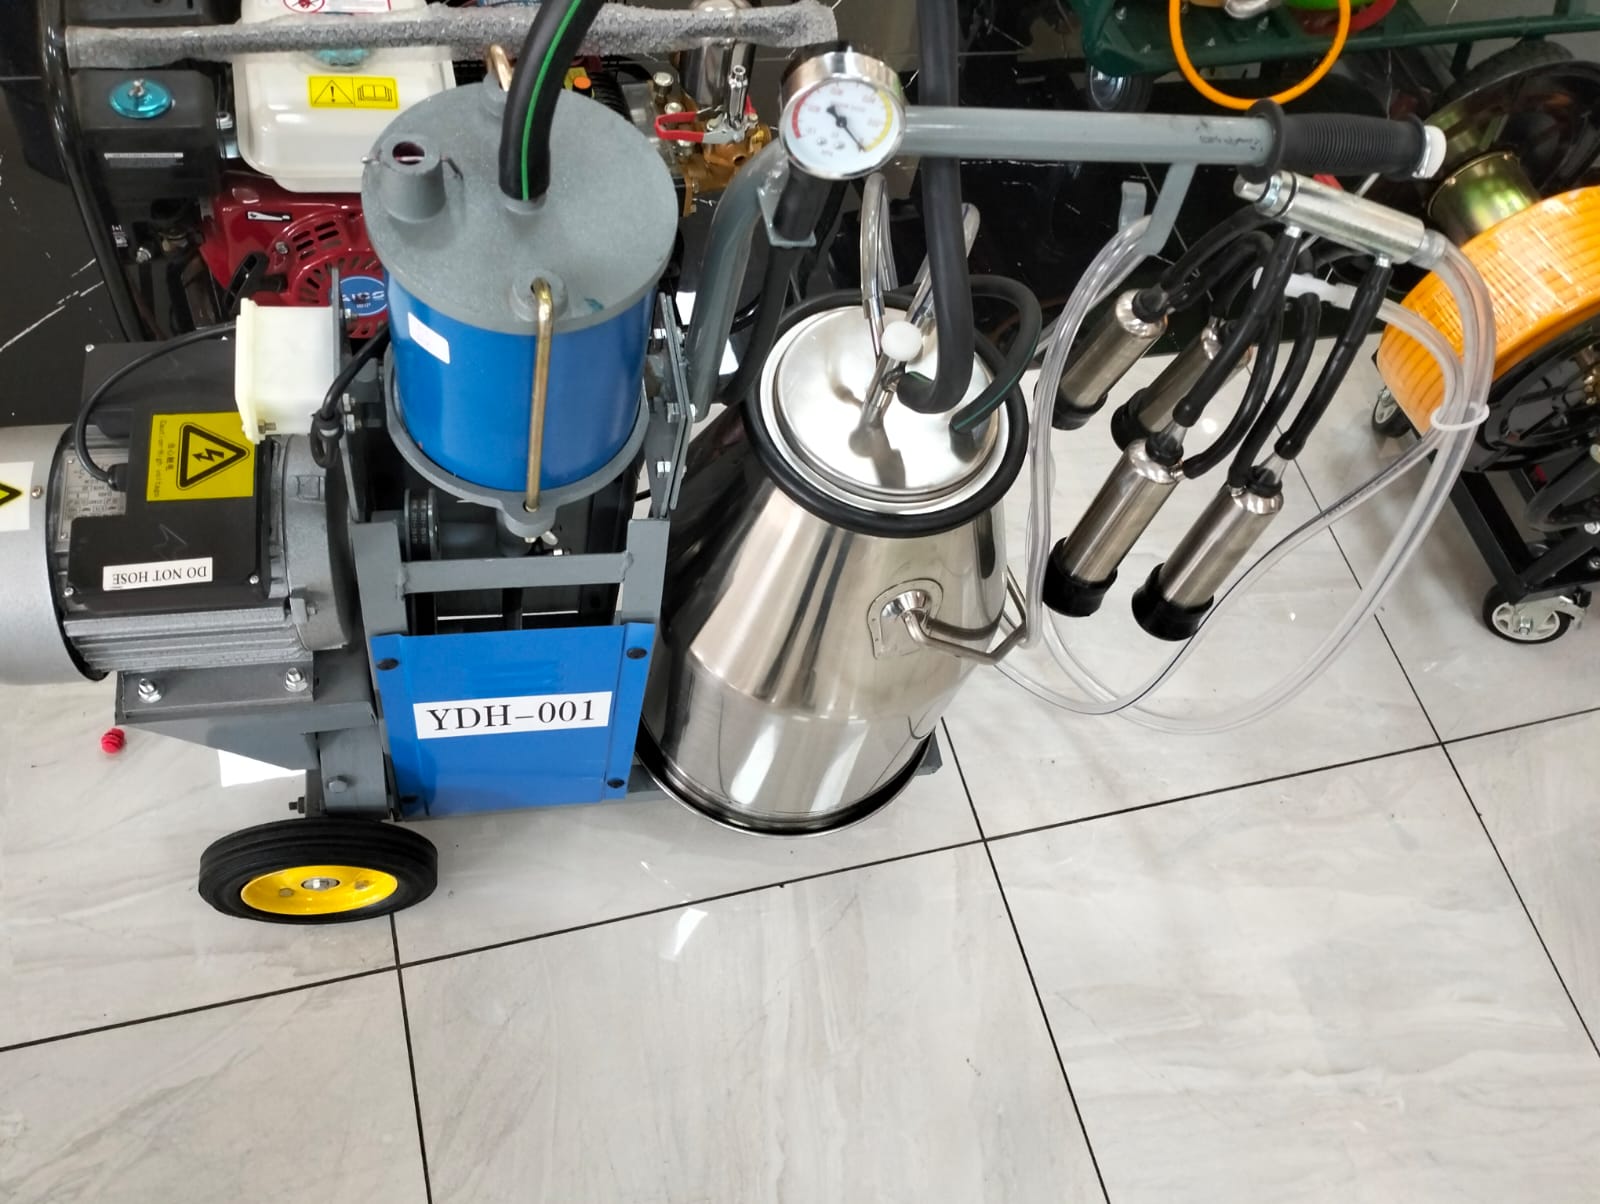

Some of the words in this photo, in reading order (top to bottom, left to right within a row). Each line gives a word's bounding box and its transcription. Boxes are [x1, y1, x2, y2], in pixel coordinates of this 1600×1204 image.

[112, 571, 148, 585] HOSE
[152, 568, 182, 582] NOT
[187, 566, 207, 578] DO
[426, 699, 594, 731] YDH-001
